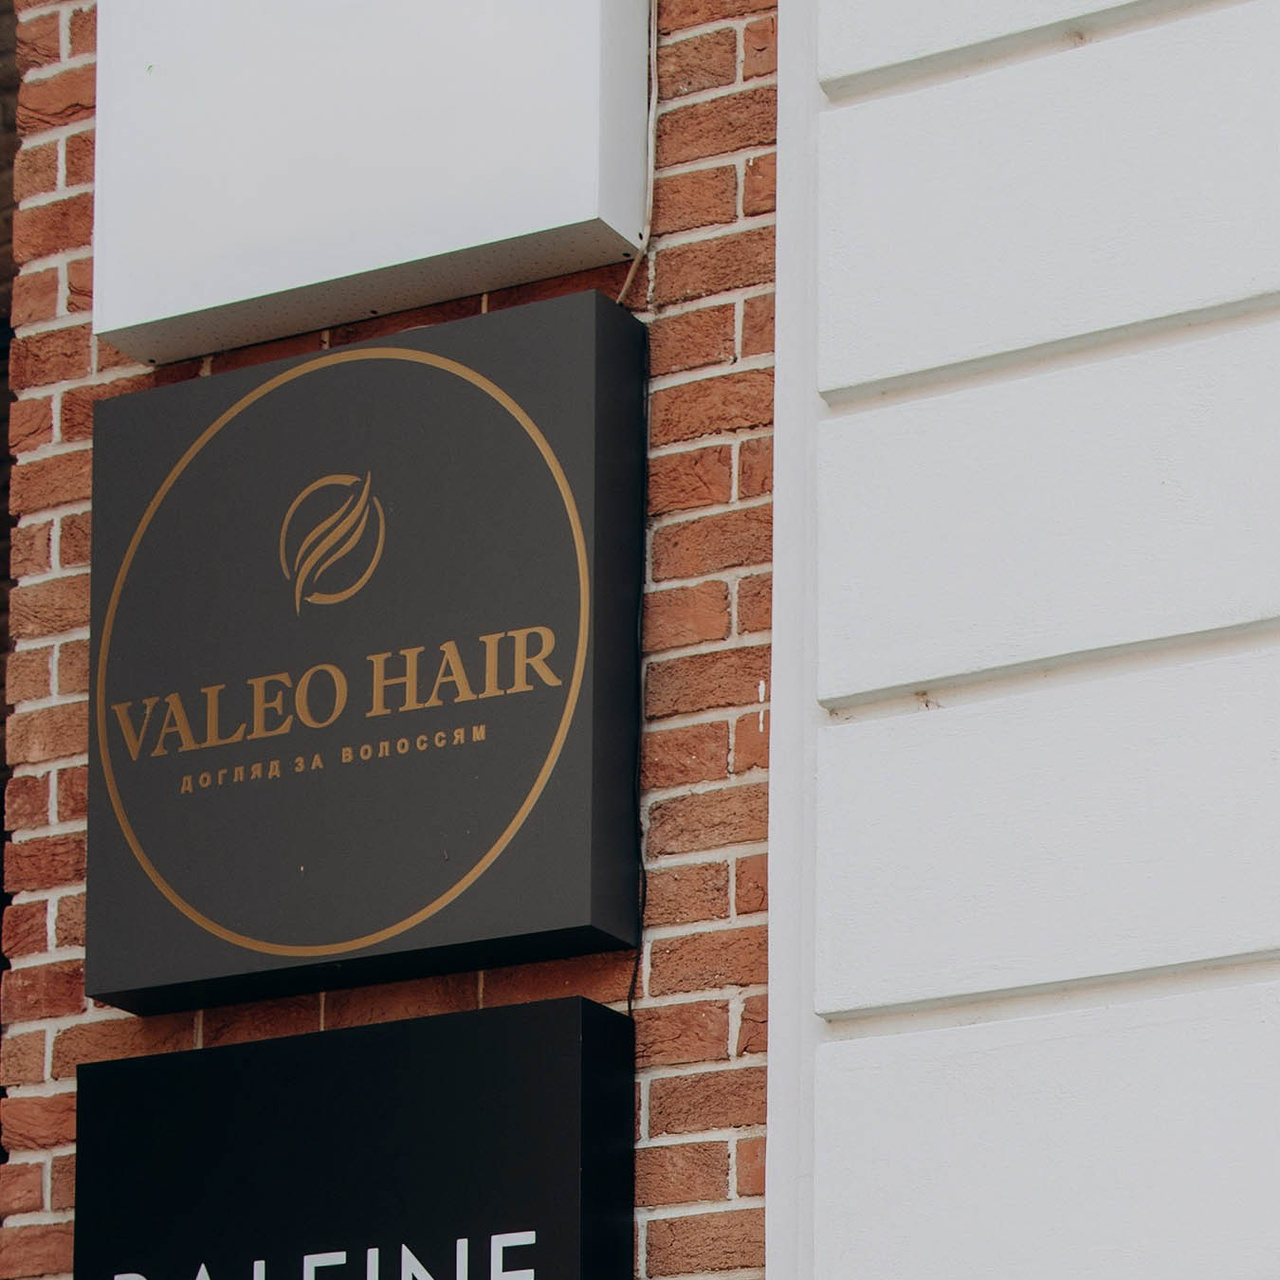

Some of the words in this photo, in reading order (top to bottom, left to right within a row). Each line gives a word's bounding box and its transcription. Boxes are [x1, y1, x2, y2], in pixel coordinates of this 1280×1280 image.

[112, 663, 349, 762] VALEO
[366, 625, 562, 718] HAIR
[179, 759, 281, 795] ДОГЛЯД
[294, 752, 324, 773] ЗА
[341, 723, 487, 765] ВОЛОССЯМ
